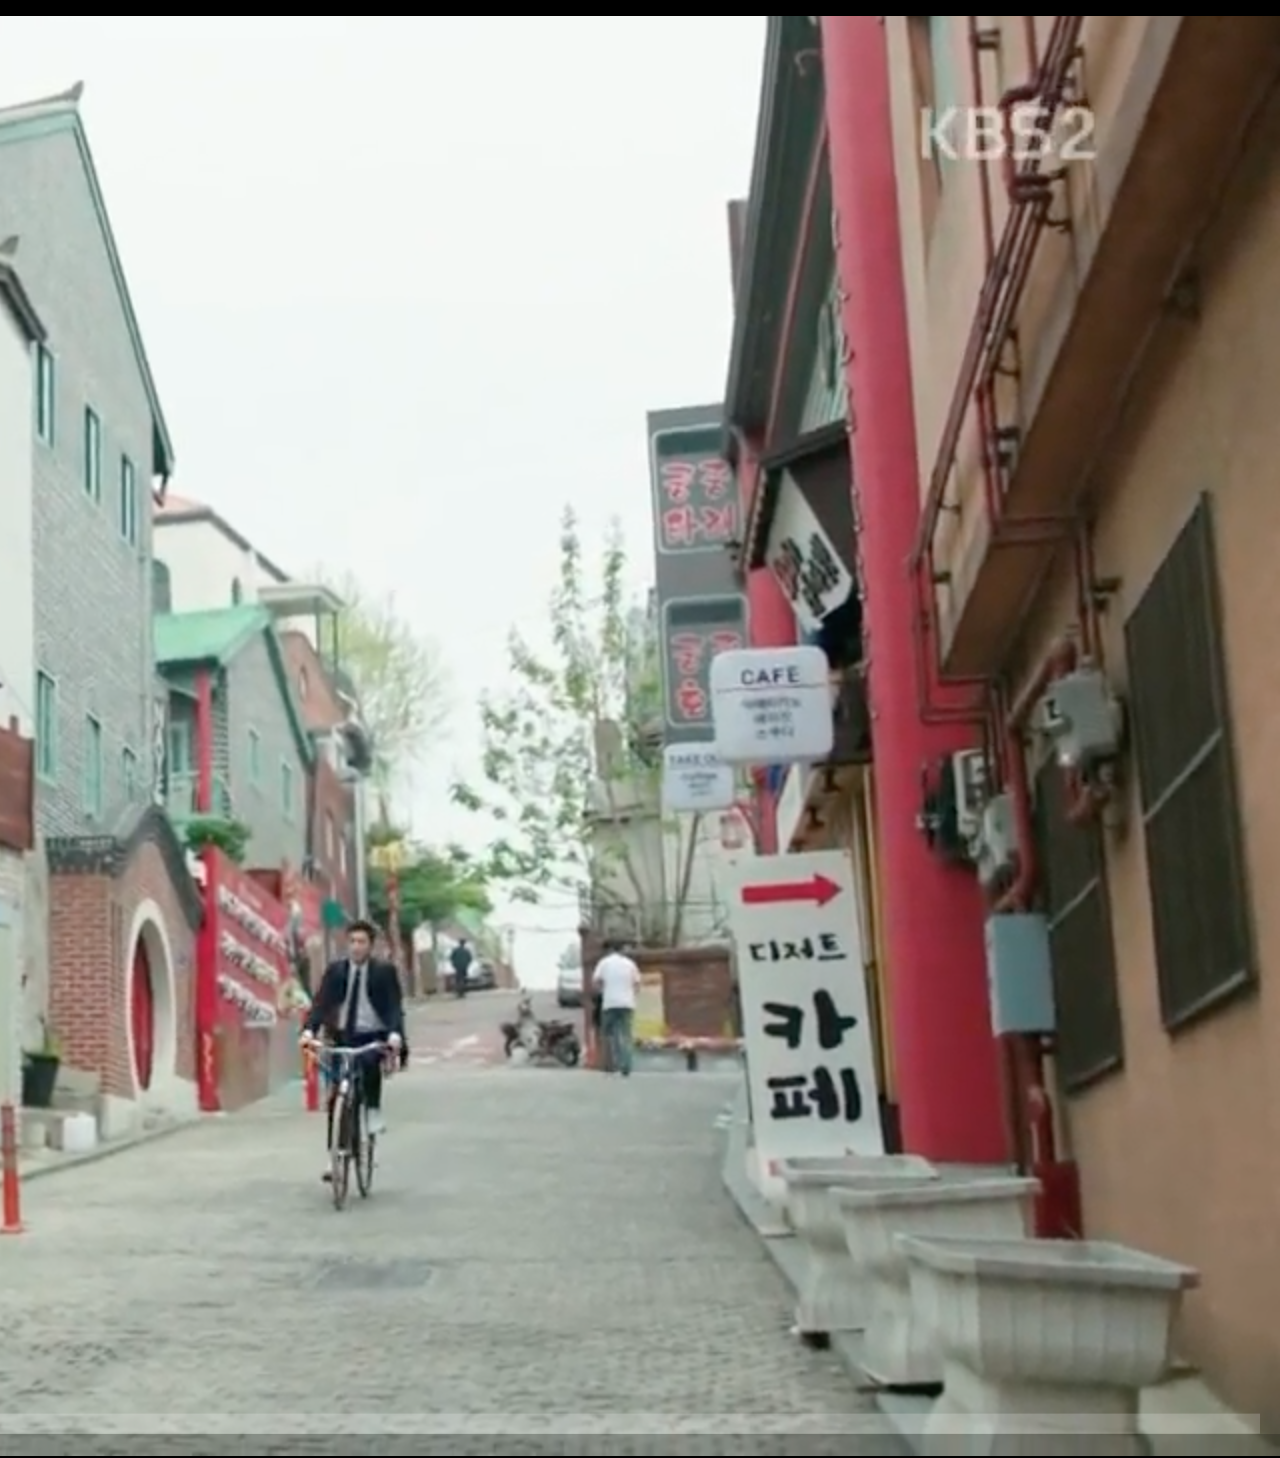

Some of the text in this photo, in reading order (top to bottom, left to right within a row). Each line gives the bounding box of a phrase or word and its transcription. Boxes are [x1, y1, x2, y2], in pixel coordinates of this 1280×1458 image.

[741, 665, 800, 686] CAFE
[748, 933, 847, 962] 디저트
[763, 988, 861, 1122] 카페
